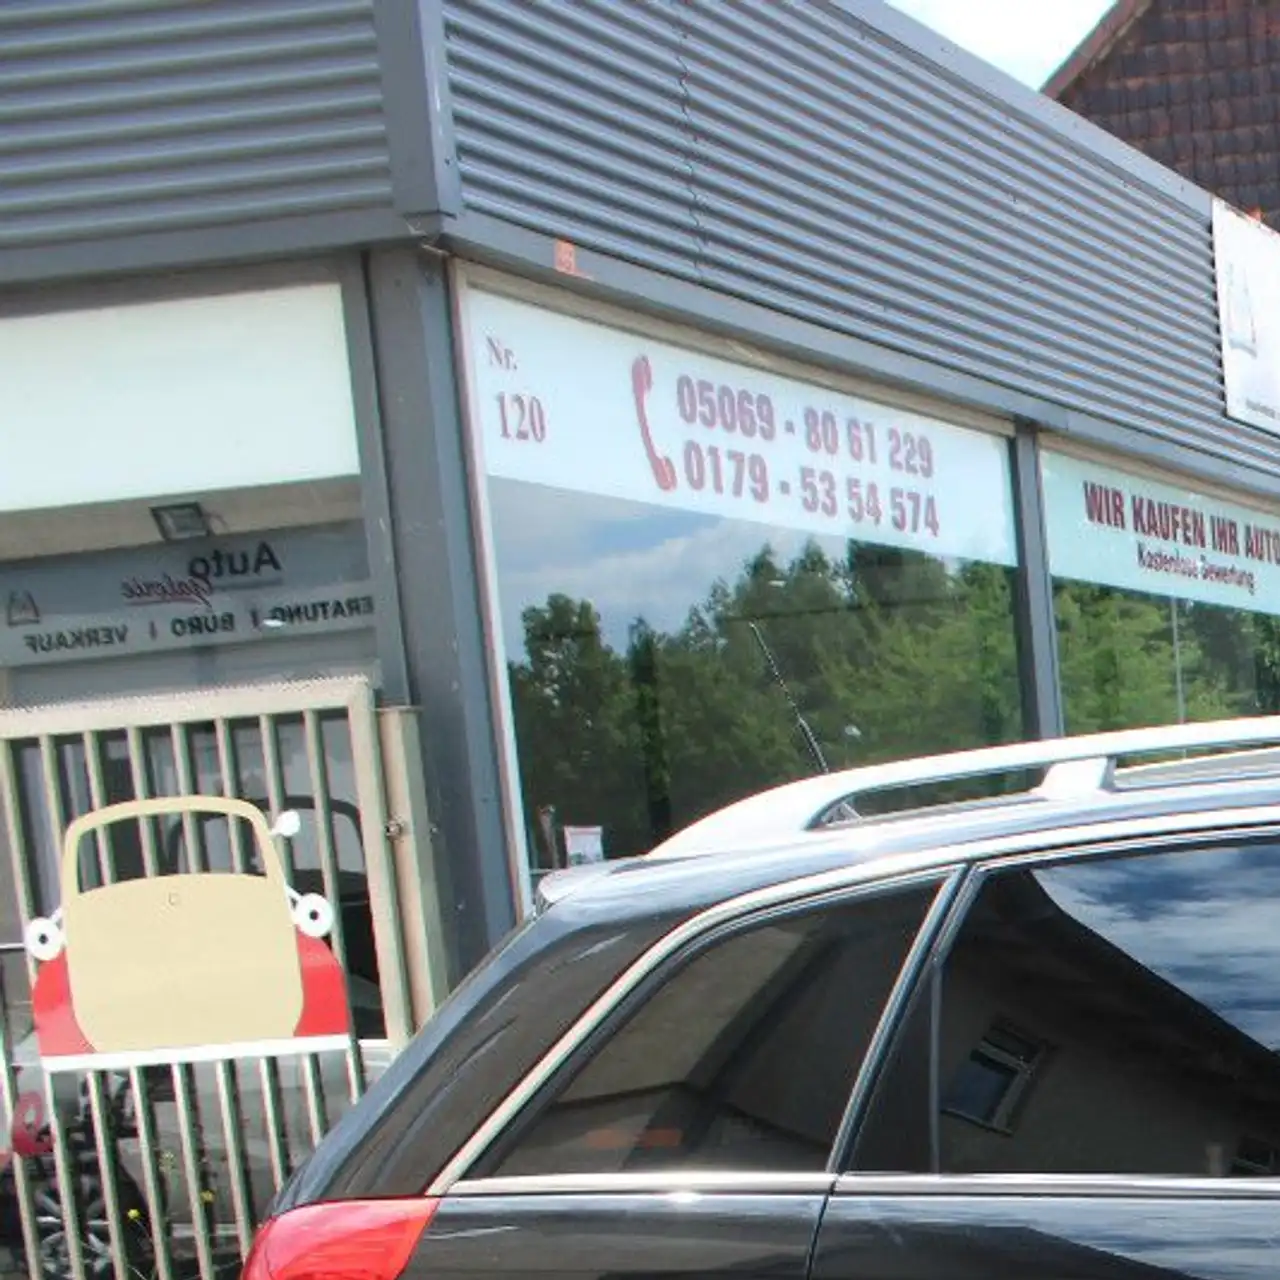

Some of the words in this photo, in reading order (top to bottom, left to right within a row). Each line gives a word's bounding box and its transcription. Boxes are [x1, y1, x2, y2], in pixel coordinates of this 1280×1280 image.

[485, 335, 518, 372] Nr.
[496, 391, 546, 443] 120
[676, 374, 775, 442] 05069
[803, 406, 839, 455] 80
[846, 417, 877, 464] 61
[887, 427, 934, 479] 229
[683, 439, 770, 503] 0179
[799, 466, 838, 518] 53
[846, 476, 882, 526] 54
[889, 486, 940, 538] 574
[1083, 480, 1125, 530] WIR
[1131, 494, 1206, 549] KAUFEN
[1210, 514, 1240, 557] IHR
